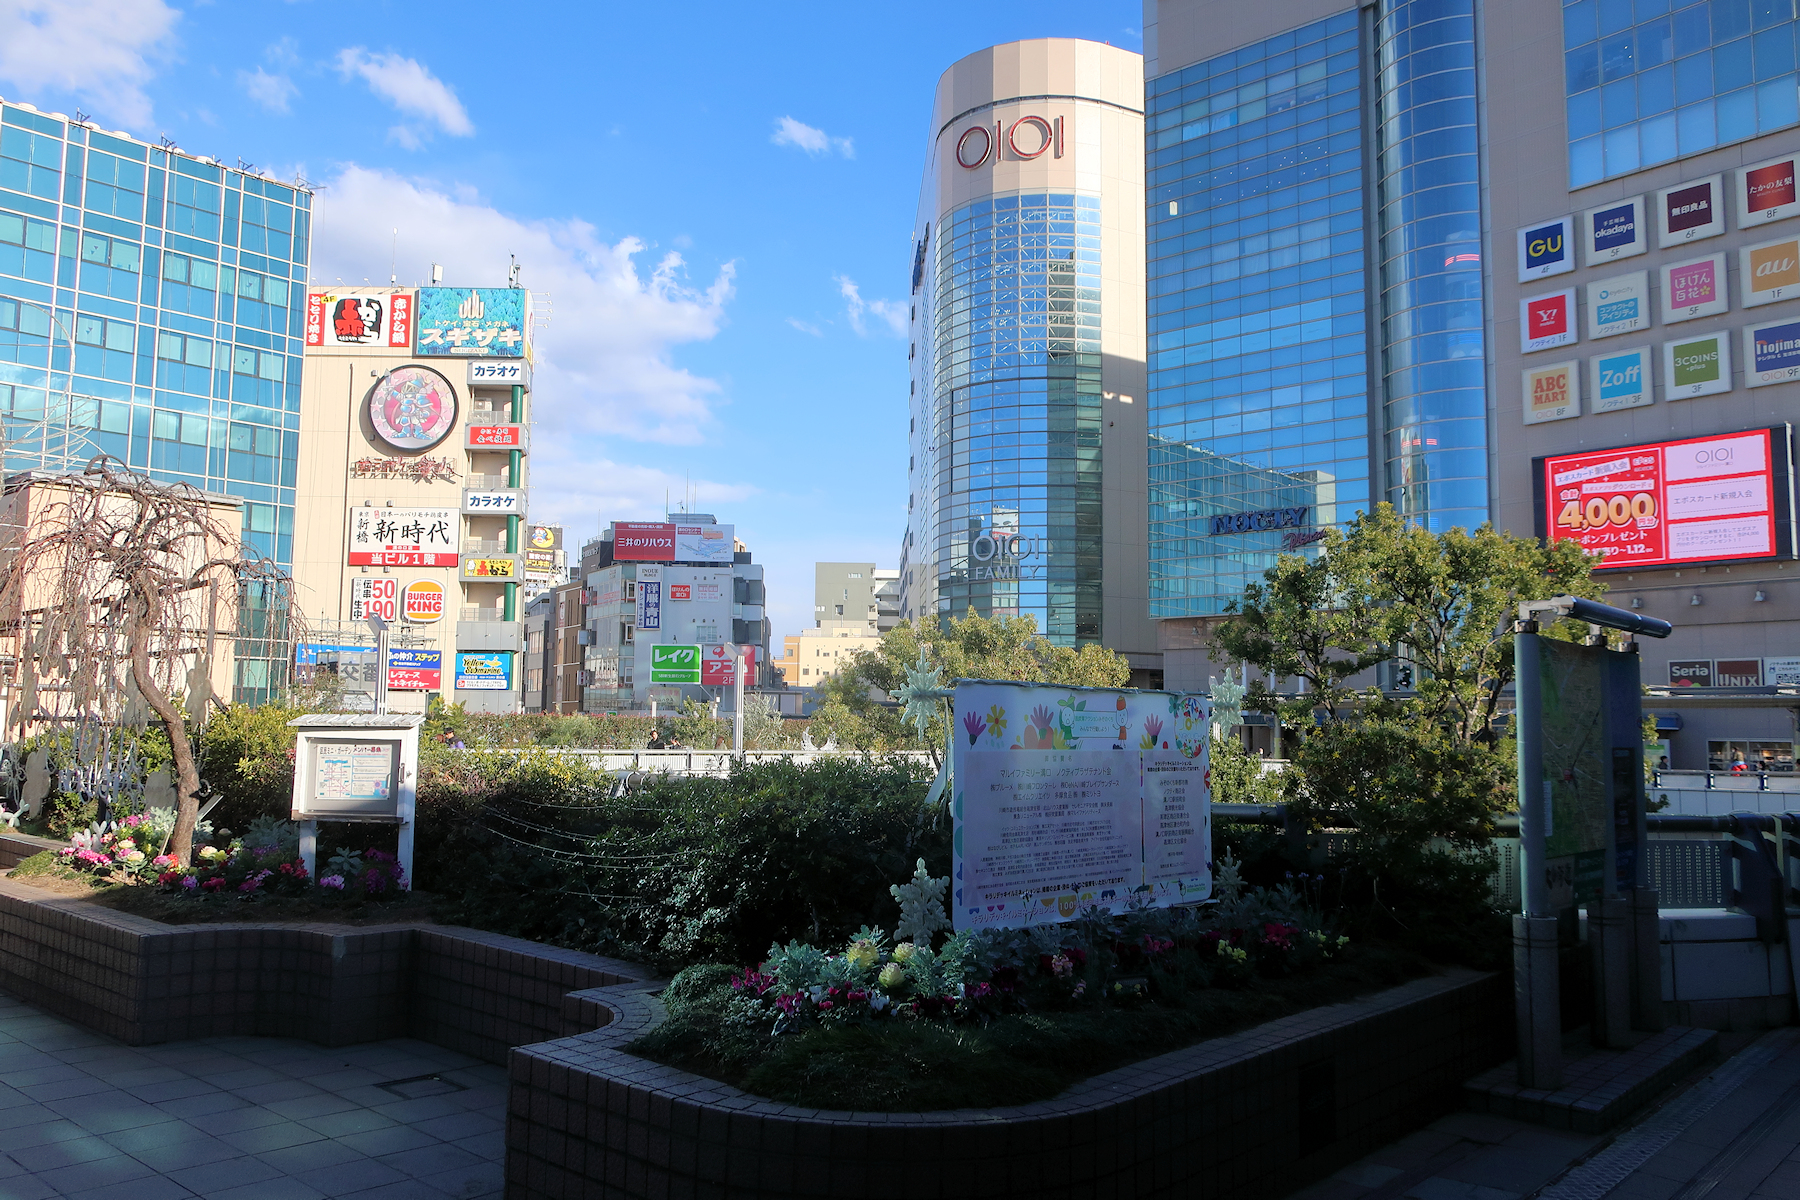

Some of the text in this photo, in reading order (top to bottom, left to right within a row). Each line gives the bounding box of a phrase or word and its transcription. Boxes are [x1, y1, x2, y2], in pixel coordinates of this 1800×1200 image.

[1749, 176, 1793, 194] たかの友梨
[1671, 200, 1708, 217] 無印良品
[1766, 208, 1778, 219] 8F
[1595, 222, 1634, 238] okadaya
[1685, 228, 1696, 239] 6F
[1528, 235, 1562, 257] GU
[1610, 248, 1620, 257] 5F
[1541, 265, 1550, 273] 4F
[1756, 257, 1795, 277] au
[1674, 273, 1710, 289] ほけん
[1675, 287, 1700, 302] 百花
[1771, 288, 1782, 299] 1F
[1600, 300, 1635, 313] コンタクトの
[1688, 305, 1699, 316] 5F
[308, 295, 320, 343] セセリ焼き
[392, 298, 407, 343] 赤から鍋
[1536, 308, 1558, 322] Y!
[1600, 309, 1635, 322] アイシティ
[434, 319, 510, 328] トケイ・宝石・メガネ
[1598, 318, 1639, 334] ノクティ2 1F
[420, 327, 522, 347] スギザキ
[1529, 333, 1568, 348] ノクティ2 1F
[1756, 338, 1800, 355] nojima
[1675, 351, 1718, 367] 3COINS
[474, 366, 520, 377] カラオケ
[1601, 364, 1640, 388] Zoff
[1787, 368, 1799, 377] 9F
[1534, 374, 1566, 394] ABC
[1691, 384, 1703, 393] 3F
[1534, 390, 1567, 405] MART
[1631, 395, 1642, 404] 3F
[1556, 407, 1566, 416] 8F
[1633, 456, 1655, 466] EPOS
[1557, 461, 1628, 483] エポスカード新規入会
[1561, 489, 1578, 499] 合計
[1673, 490, 1753, 505] エポスカード新規入会
[469, 496, 515, 507] カラオケ
[1557, 492, 1655, 530] 4,000
[1210, 507, 1309, 535] NOCTY
[1637, 517, 1656, 527] 円分
[356, 518, 370, 543] 新橋
[372, 519, 450, 544] 新時代
[617, 537, 673, 547] 三井のリハウス
[975, 565, 1040, 580] FAMILY
[363, 580, 396, 599] 伝串 50
[407, 592, 443, 601] BURGER
[353, 600, 395, 620] 生中 190
[407, 601, 442, 612] KING
[645, 583, 660, 627] 洋服の青山
[414, 653, 440, 662] ステップ
[464, 658, 486, 666] Yellow
[654, 649, 695, 663] レイク
[341, 661, 376, 681] 交番
[465, 666, 502, 674] Submarine
[1671, 664, 1709, 677] Seria
[1000, 766, 1112, 778] マルイファミリー溝口 ノクティプラザテナント会
